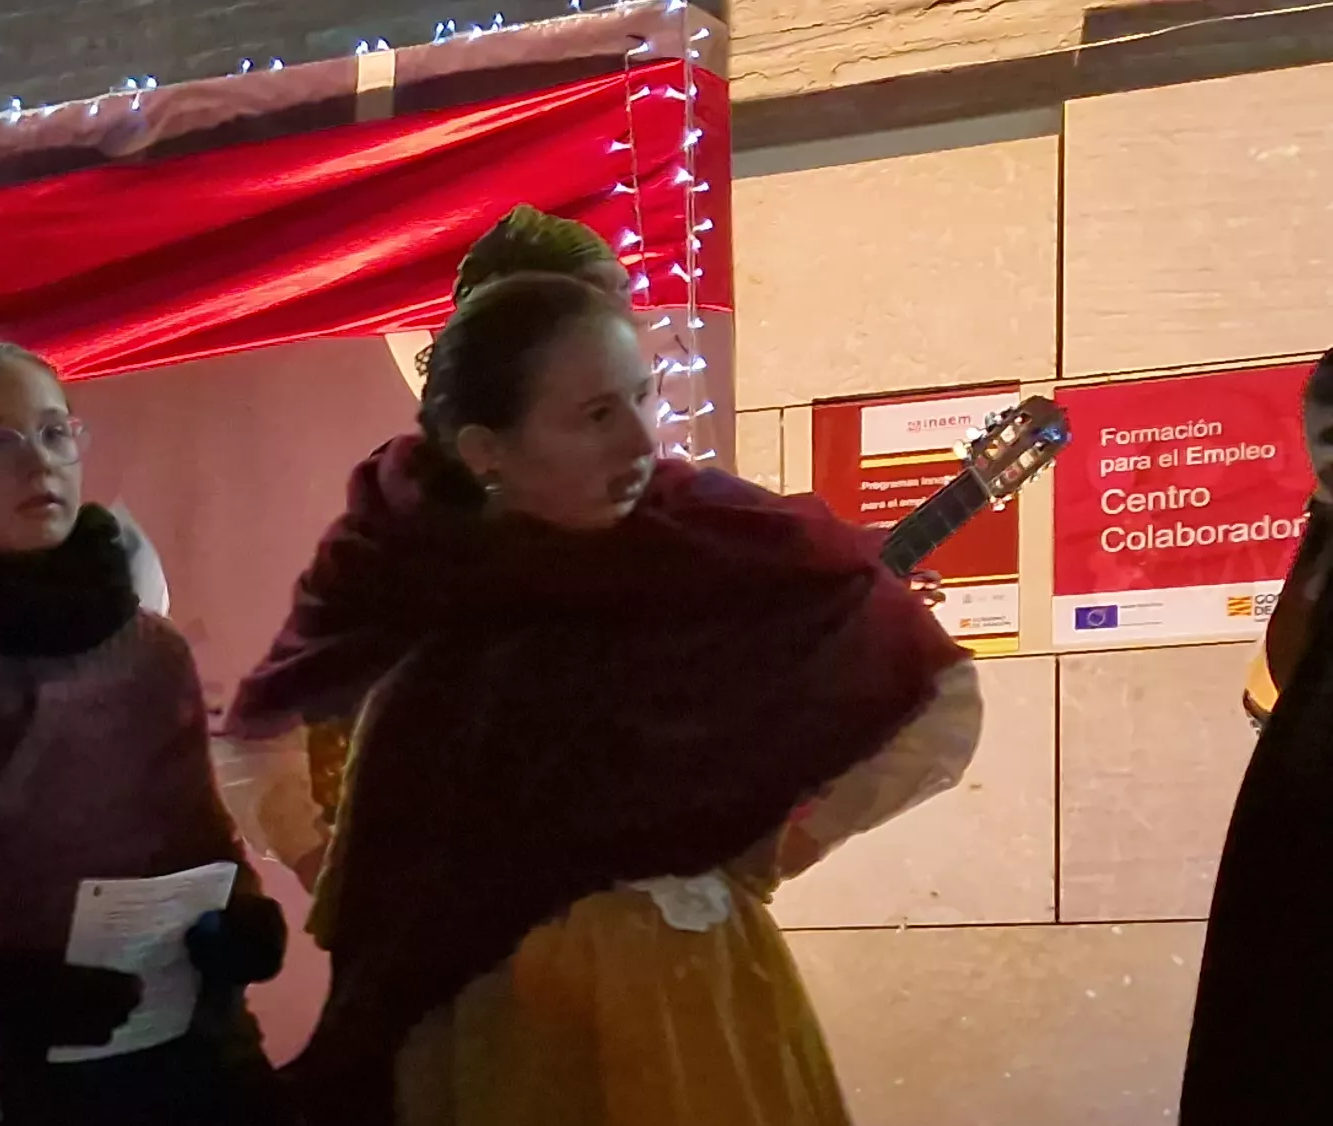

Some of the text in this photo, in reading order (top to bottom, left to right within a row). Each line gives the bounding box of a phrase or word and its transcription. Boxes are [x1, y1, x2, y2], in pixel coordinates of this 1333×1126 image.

[1100, 418, 1223, 447] Formación
[1100, 442, 1277, 477] para el Empleo
[1100, 485, 1211, 515] Centro
[1100, 512, 1307, 553] Colaborador
